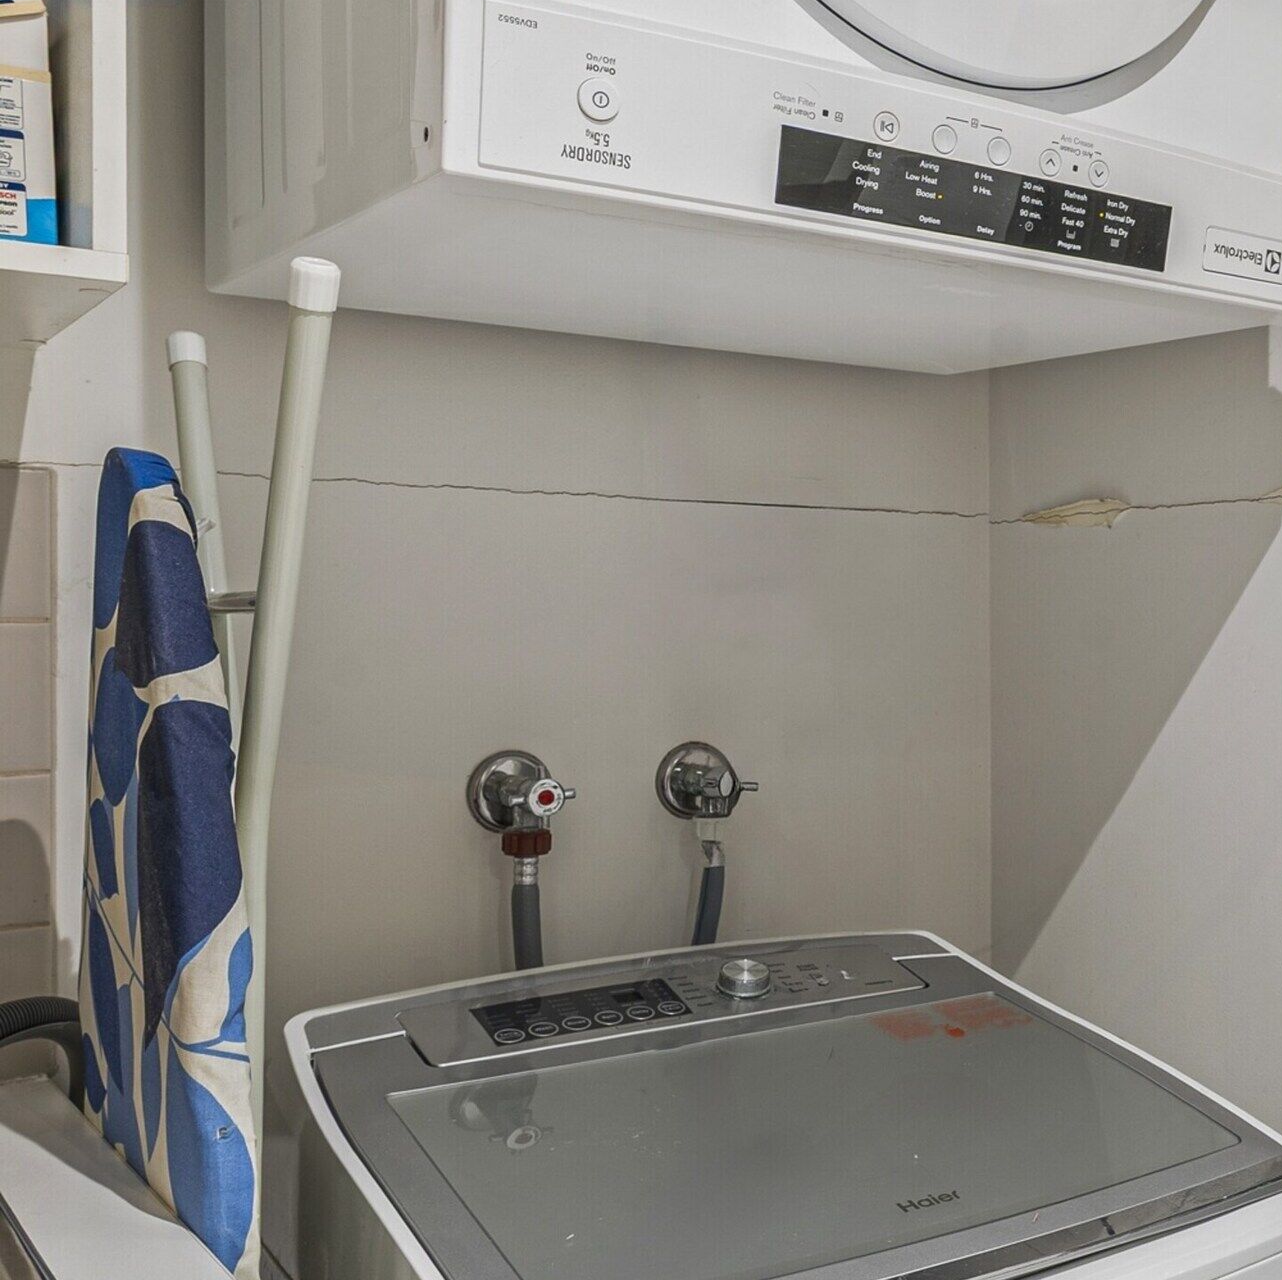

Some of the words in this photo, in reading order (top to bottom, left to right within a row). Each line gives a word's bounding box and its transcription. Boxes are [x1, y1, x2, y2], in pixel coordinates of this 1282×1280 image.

[498, 13, 538, 29] EDV5552
[586, 52, 616, 65] On/Off
[586, 63, 616, 75] On/Off
[773, 91, 796, 103] Clean
[798, 95, 816, 108] Filter
[773, 103, 792, 115] Filter
[794, 108, 816, 120] Clean
[561, 143, 632, 170] SENSORDRY
[867, 149, 882, 160] End
[852, 161, 881, 175] Cooling
[919, 160, 940, 173] Airing
[855, 176, 879, 190] Drying
[905, 171, 920, 182] Low
[921, 174, 938, 185] Heat
[980, 172, 994, 182] Hrs.
[916, 188, 936, 200] Boost
[978, 186, 992, 196] Hrs.
[1032, 184, 1046, 193] min.
[1030, 197, 1044, 206] min.
[1064, 189, 1088, 202] Refresh
[853, 203, 884, 215] Progress
[1061, 203, 1086, 215] Delicate
[1106, 198, 1118, 208] Iron
[1118, 201, 1129, 212] Dry
[918, 214, 941, 226] Option
[1029, 211, 1042, 220] min.
[1105, 212, 1125, 223] Normal
[1125, 216, 1136, 227] Dry
[1061, 217, 1075, 227] Fast
[1075, 219, 1085, 228] 40
[976, 225, 995, 236] Delay
[1103, 225, 1117, 235] Extra
[1118, 227, 1129, 238] Dry
[1057, 239, 1082, 251] Program
[1213, 243, 1263, 266] Electrolux
[896, 1190, 960, 1213] Haier
